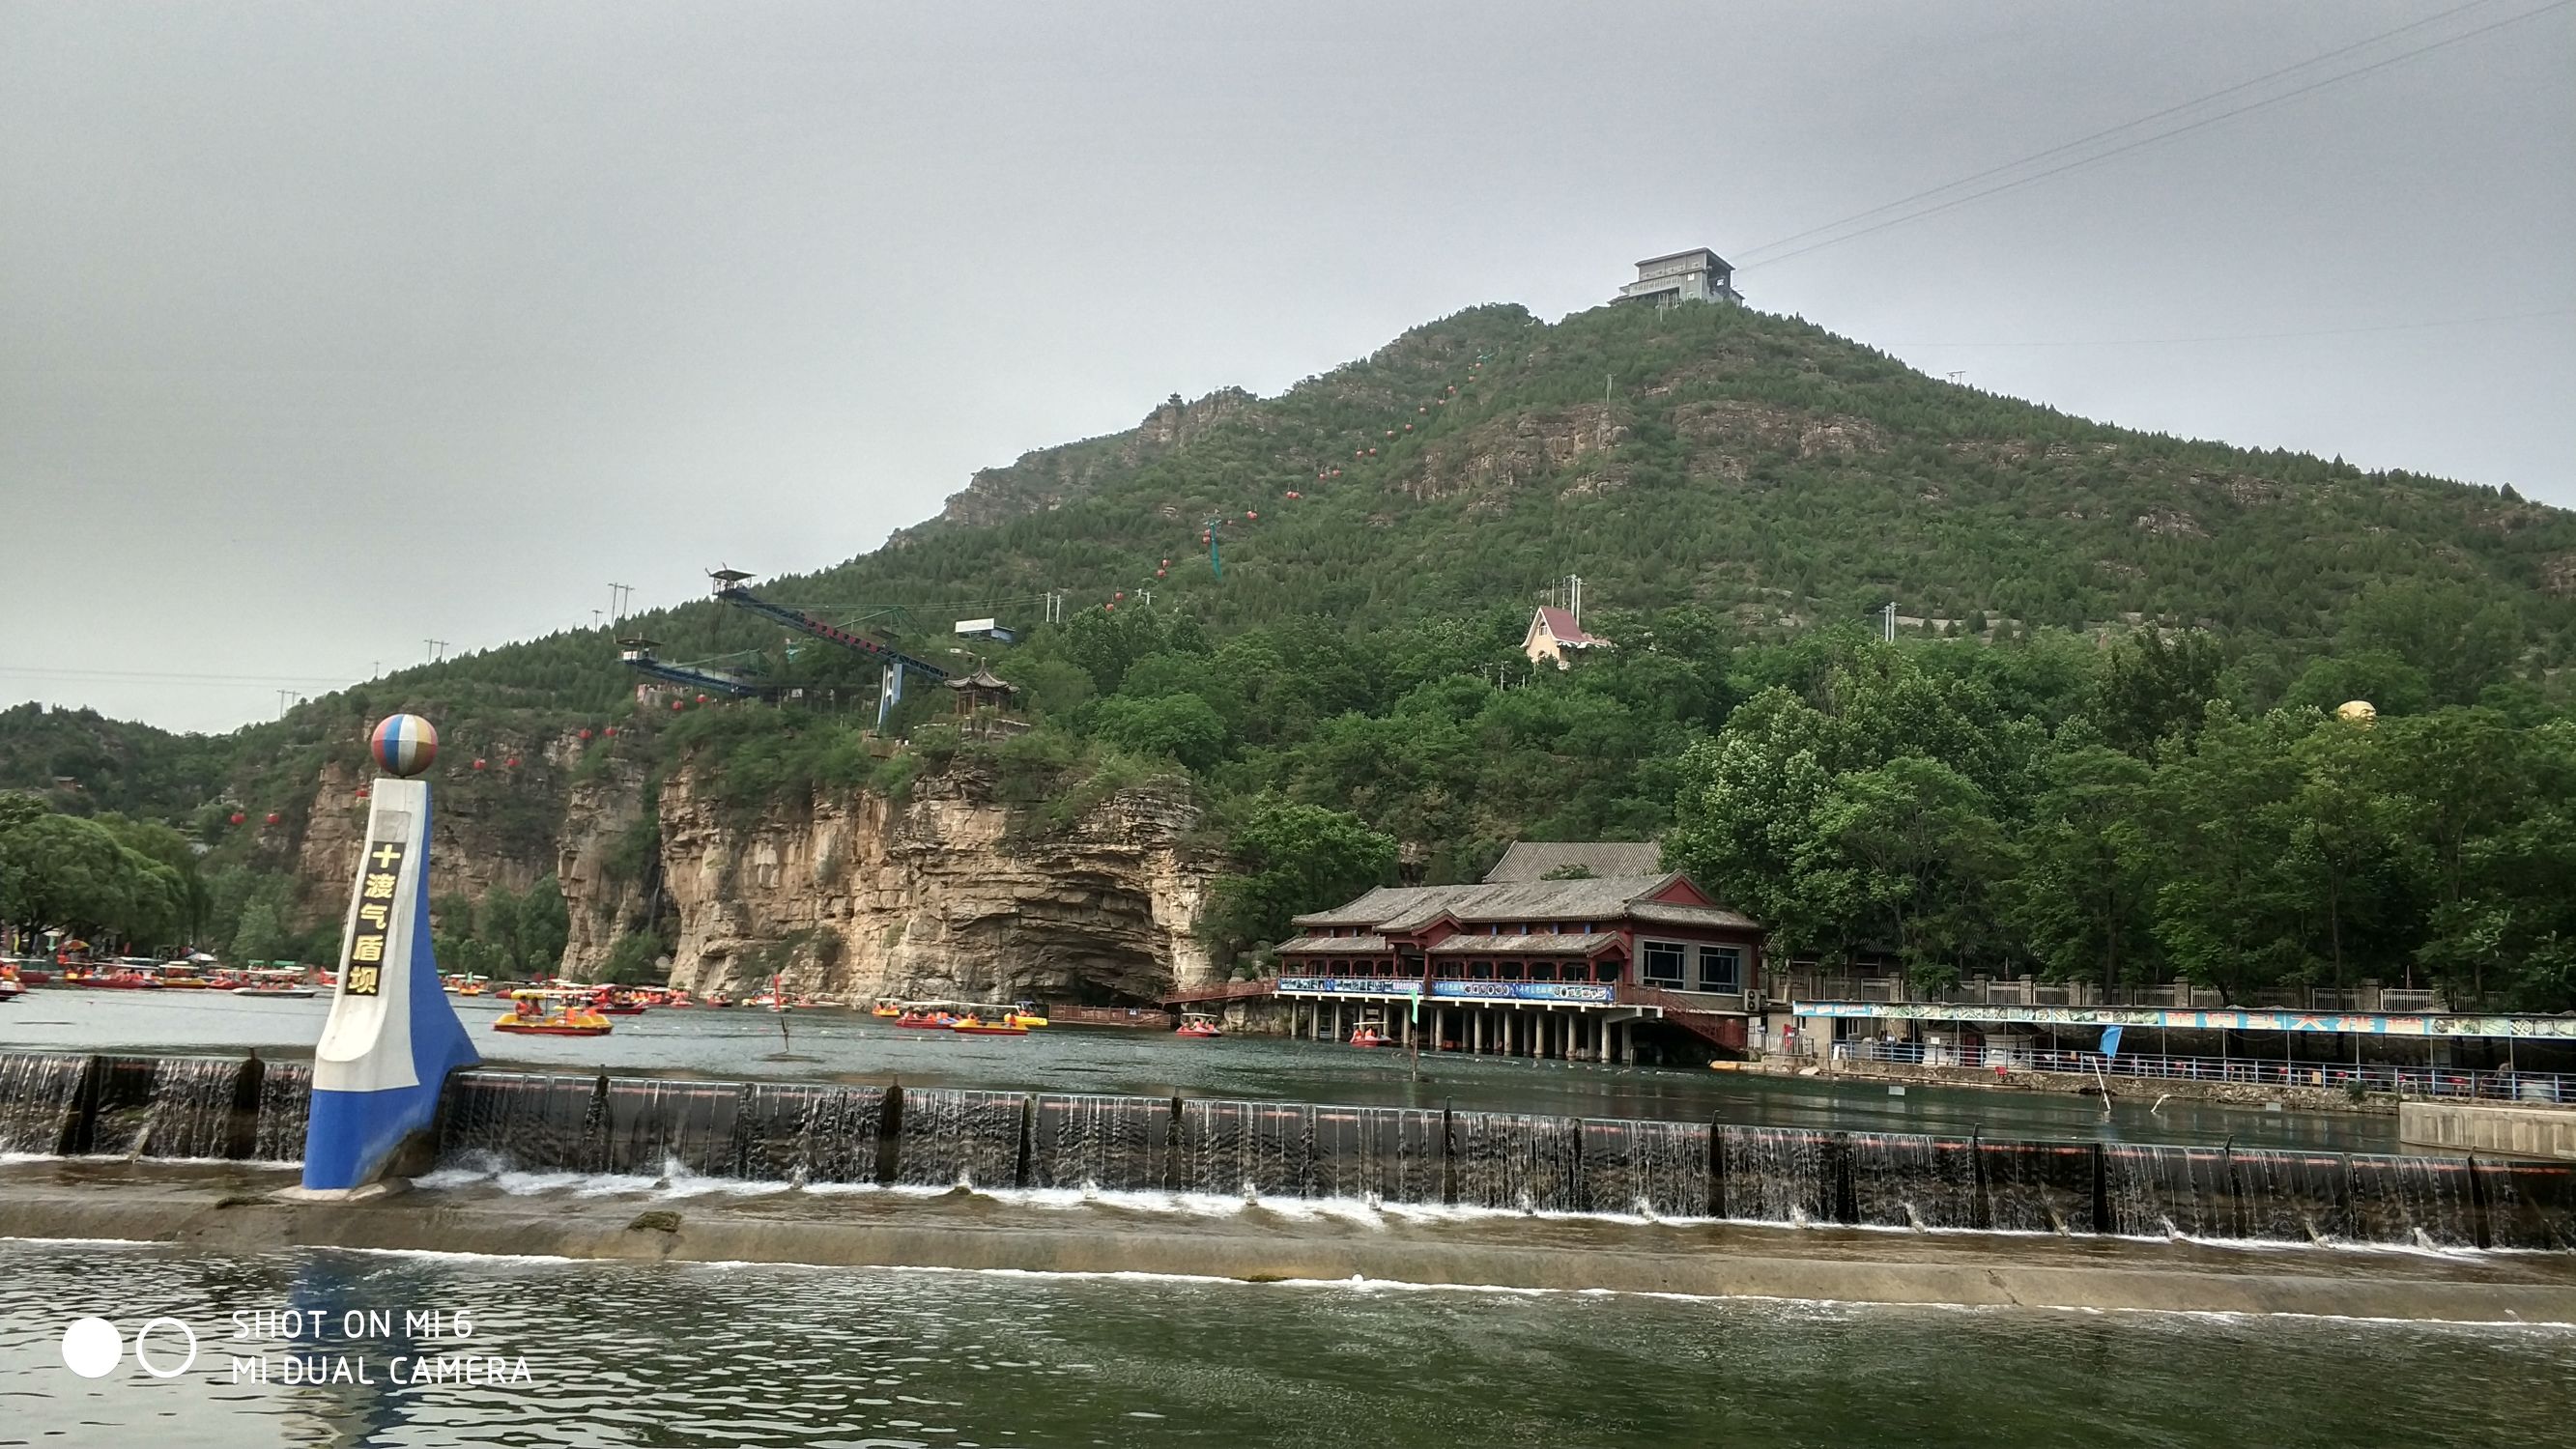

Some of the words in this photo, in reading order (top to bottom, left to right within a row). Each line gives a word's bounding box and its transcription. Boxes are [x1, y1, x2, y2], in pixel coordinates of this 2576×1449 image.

[348, 843, 401, 994] 十渡气盾坝
